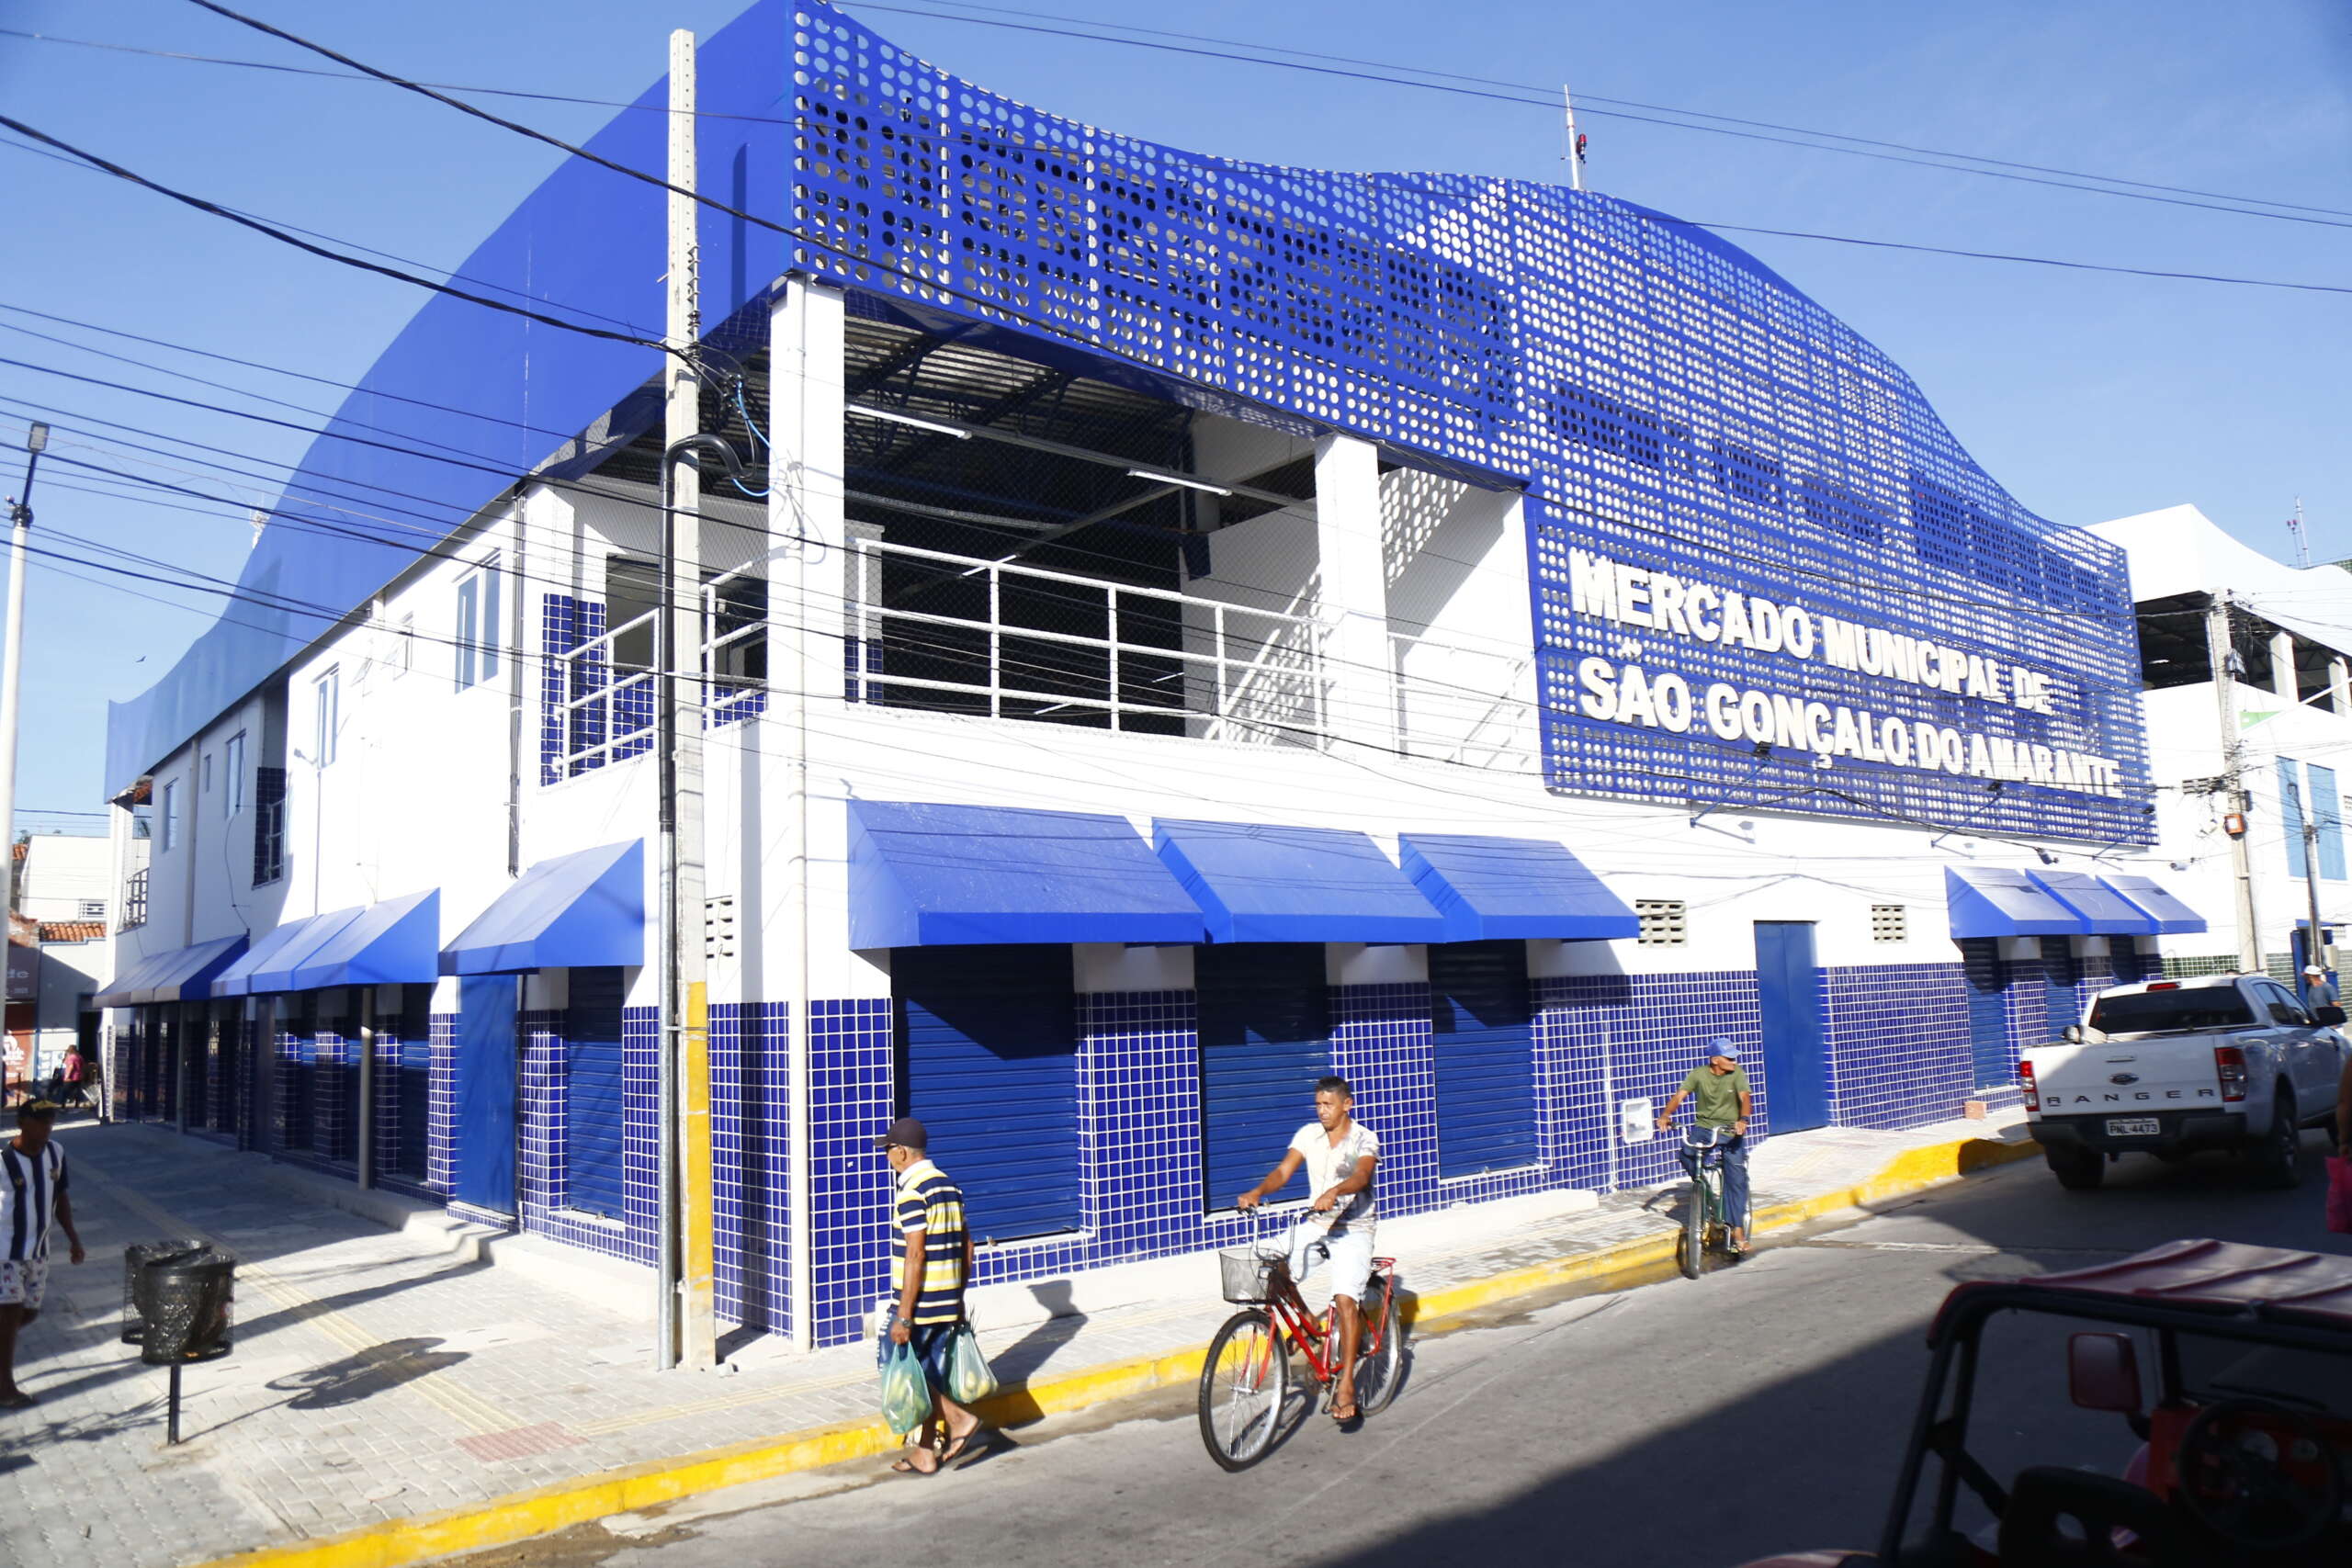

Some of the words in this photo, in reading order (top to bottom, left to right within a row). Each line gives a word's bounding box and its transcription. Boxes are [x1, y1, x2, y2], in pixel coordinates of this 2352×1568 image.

[1570, 547, 1814, 659] MERCADO
[1823, 615, 2007, 704] MUNICIPAL
[2012, 666, 2052, 716] DE
[1579, 639, 1692, 733] SÃO
[1706, 682, 1910, 770] GONÇALO
[1915, 721, 1964, 774] DO
[1970, 733, 2123, 799] AMARANTE
[2046, 1089, 2215, 1105] RANGER
